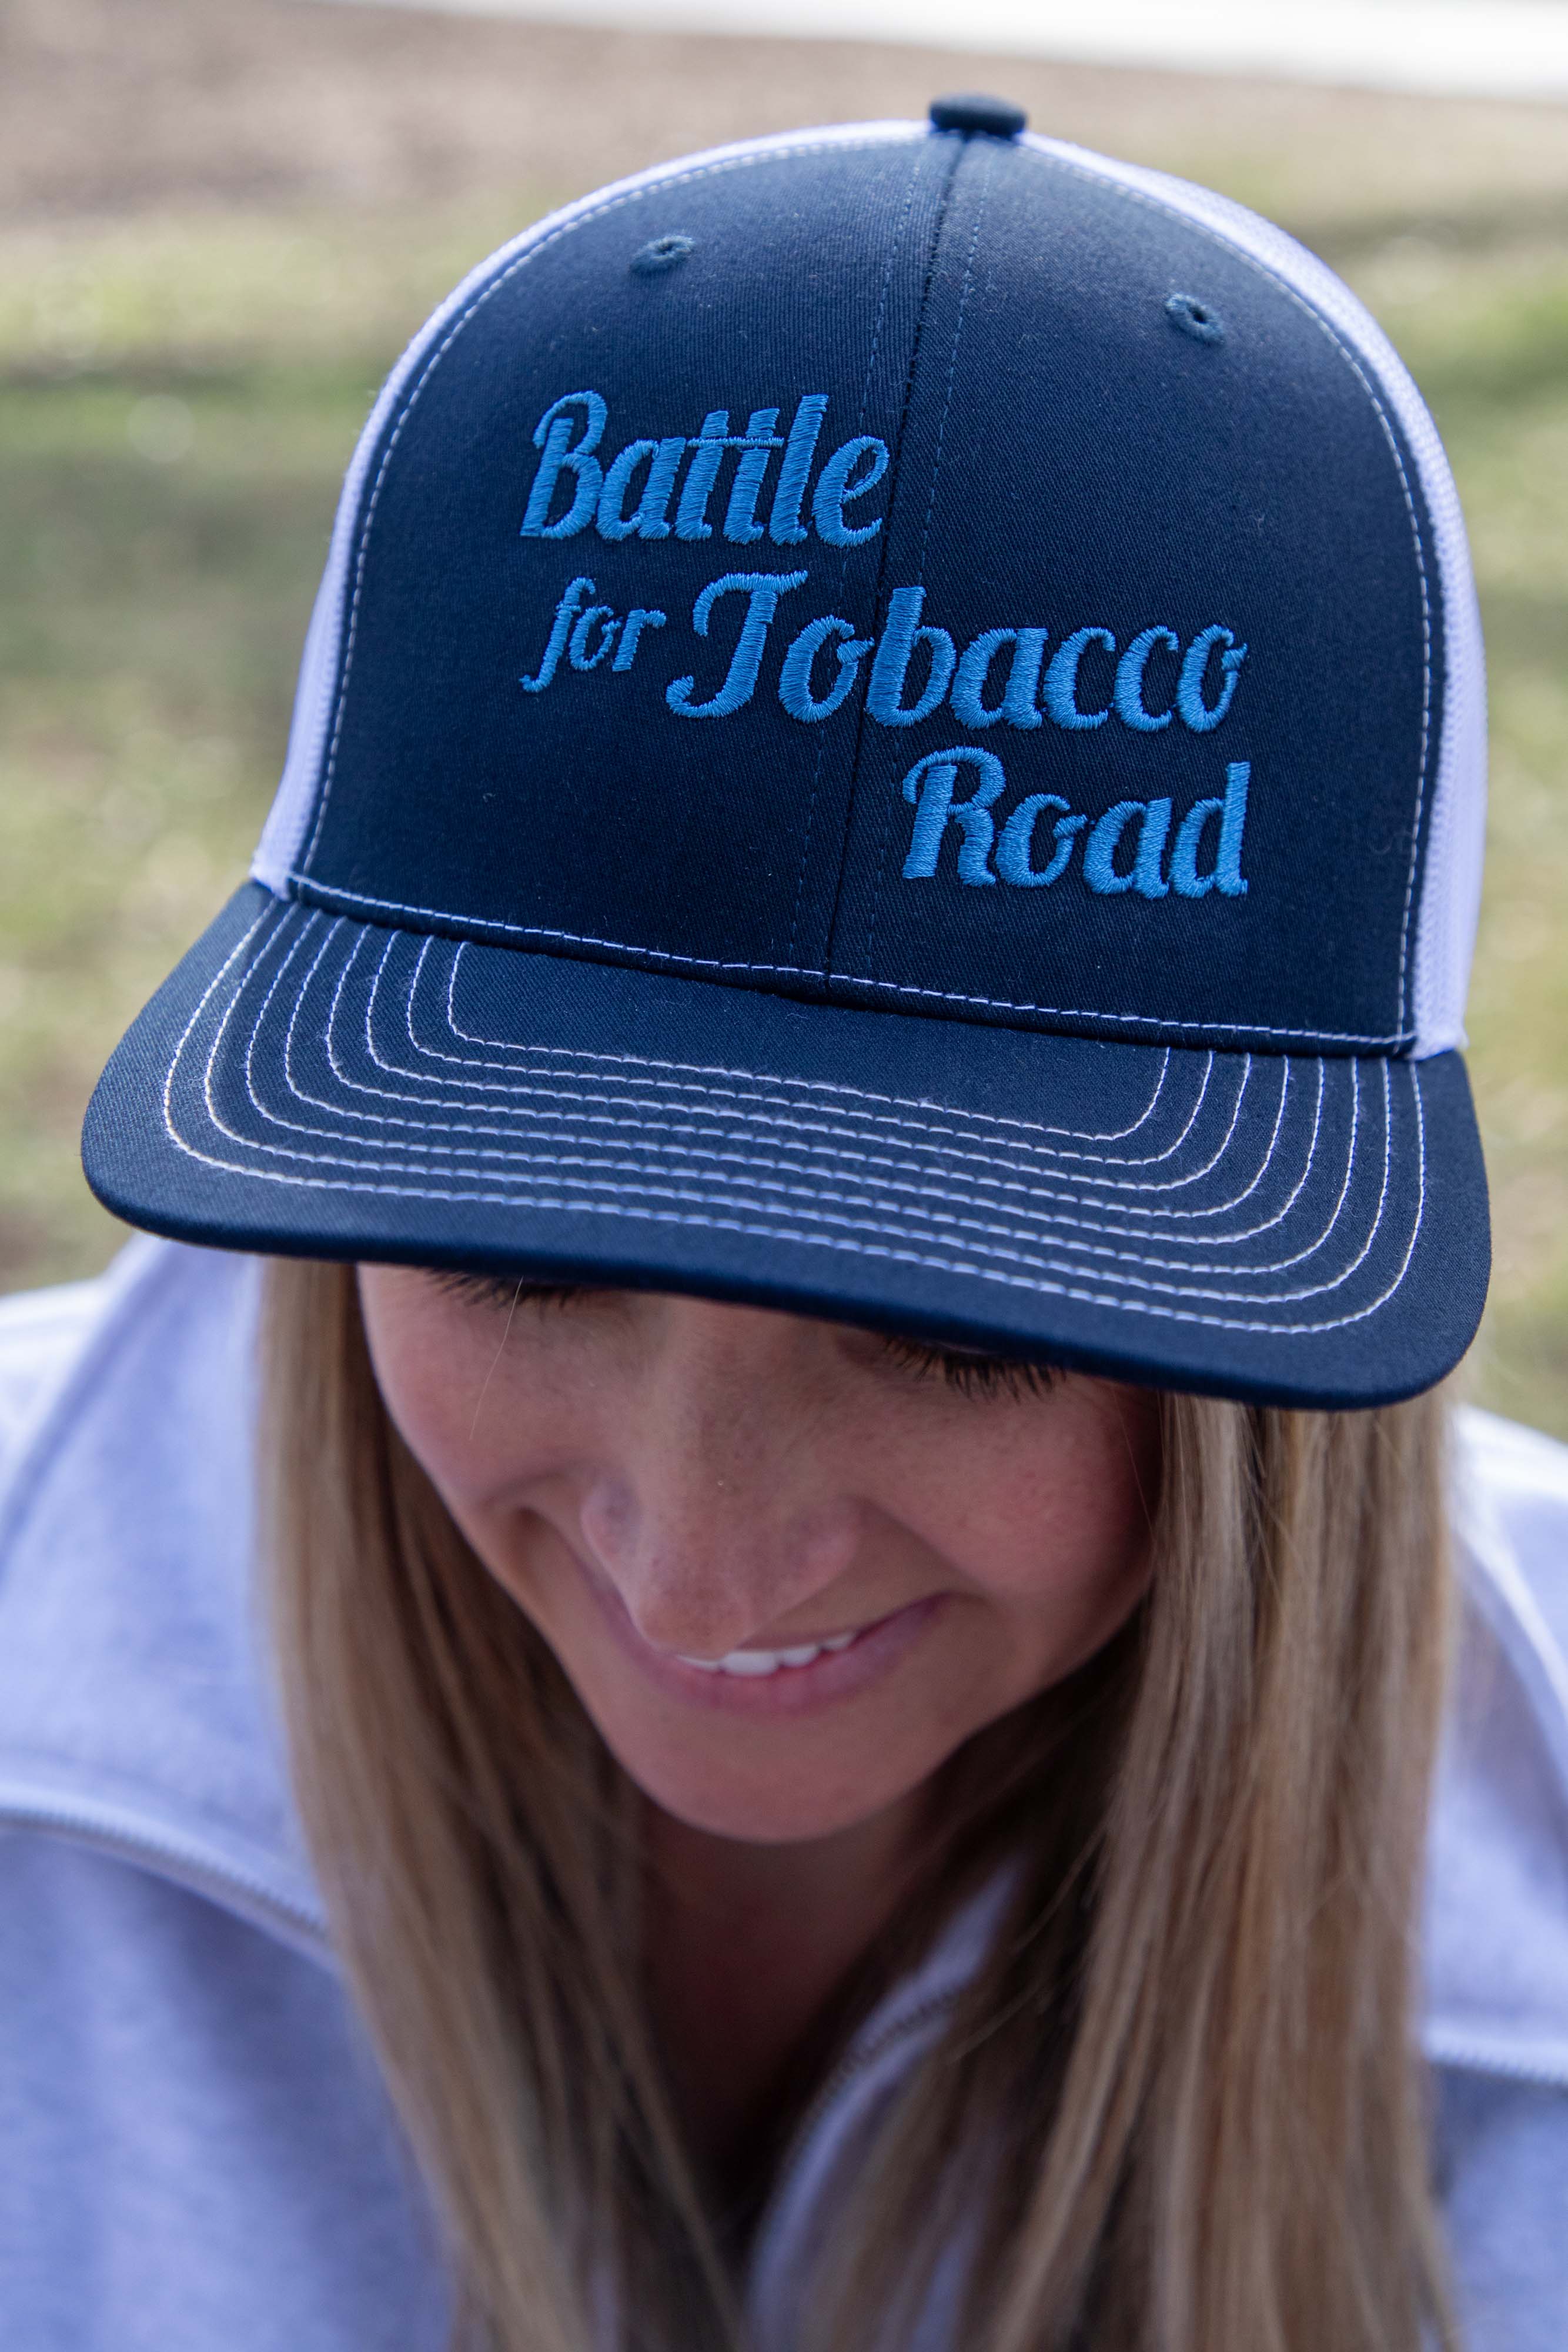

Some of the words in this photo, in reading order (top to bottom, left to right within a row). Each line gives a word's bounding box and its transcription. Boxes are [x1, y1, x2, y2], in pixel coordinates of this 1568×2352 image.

[520, 390, 890, 547] Battle
[520, 577, 666, 693] for
[666, 570, 1248, 733] Tobacco
[902, 746, 1251, 898] Road
